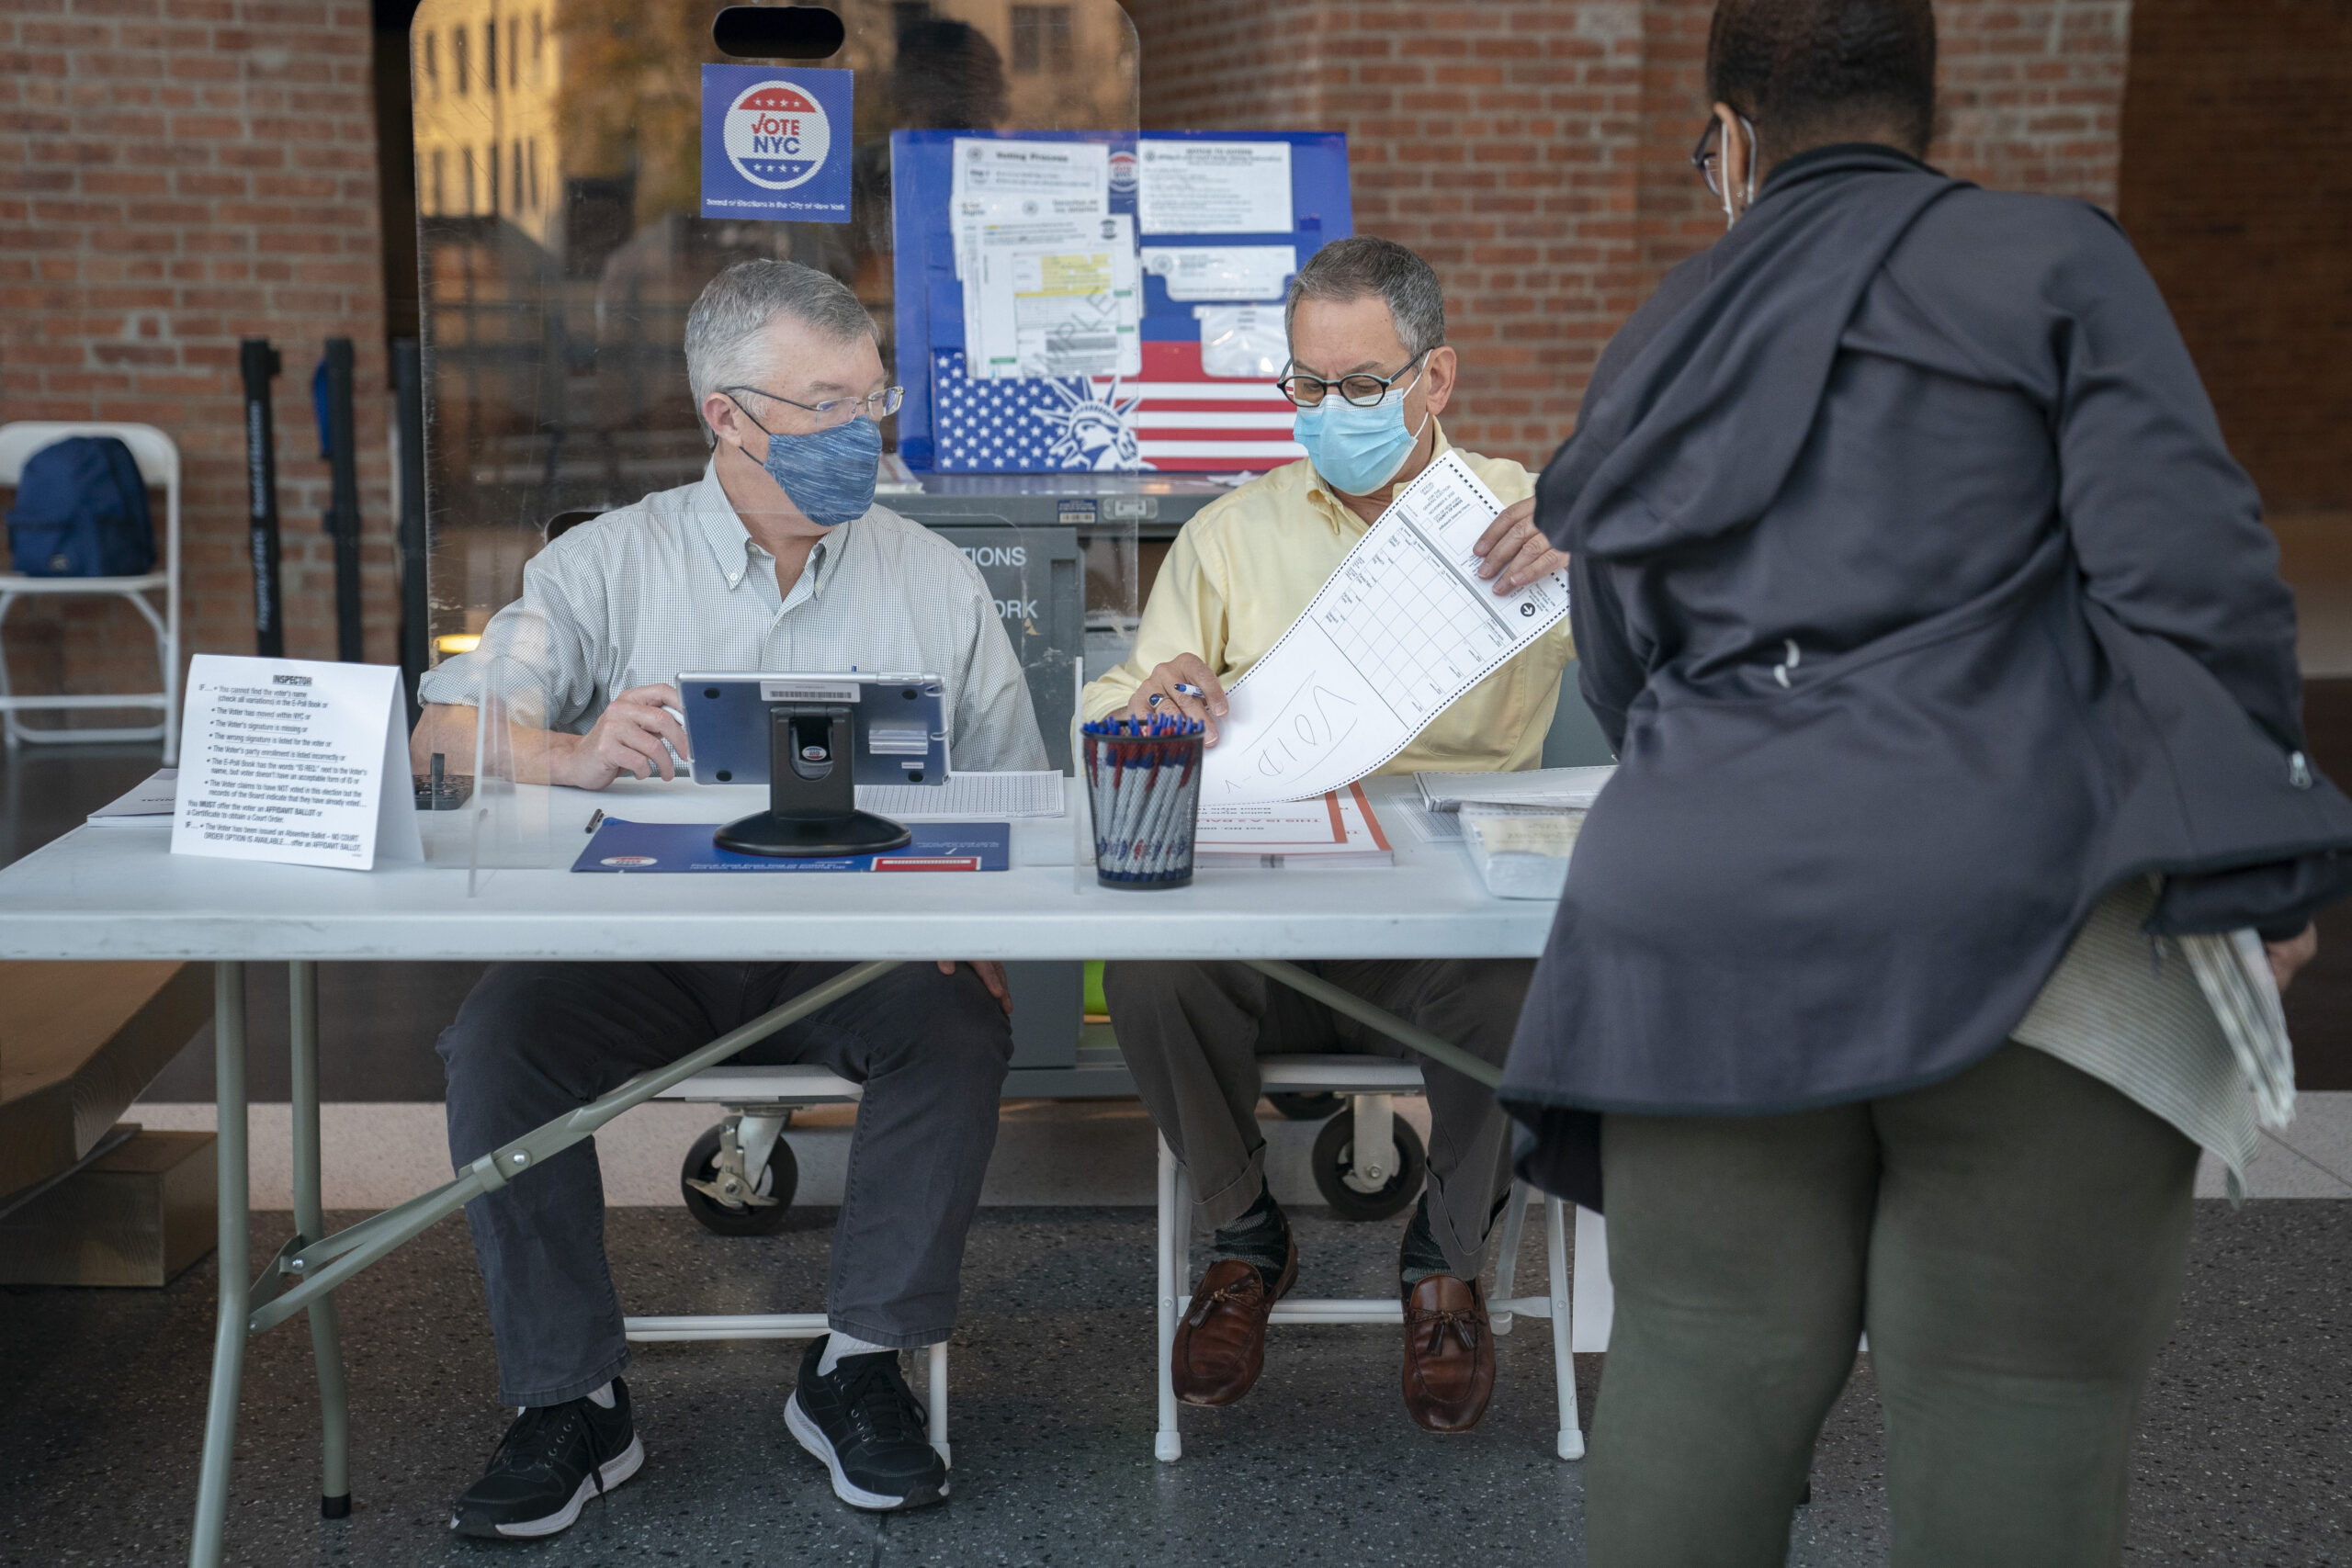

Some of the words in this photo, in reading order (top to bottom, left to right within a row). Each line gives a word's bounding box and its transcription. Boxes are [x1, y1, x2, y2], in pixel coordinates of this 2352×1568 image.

[752, 113, 800, 136] VOTE
[753, 136, 800, 155] NYC
[272, 674, 312, 685] INSPECTOR
[1259, 685, 1356, 776] VOID
[265, 805, 293, 814] AFFIDAVIT
[203, 831, 224, 840] ORDER
[223, 833, 247, 841] OPTION
[311, 840, 339, 849] AFFIDAVIT
[339, 833, 358, 841] COURT
